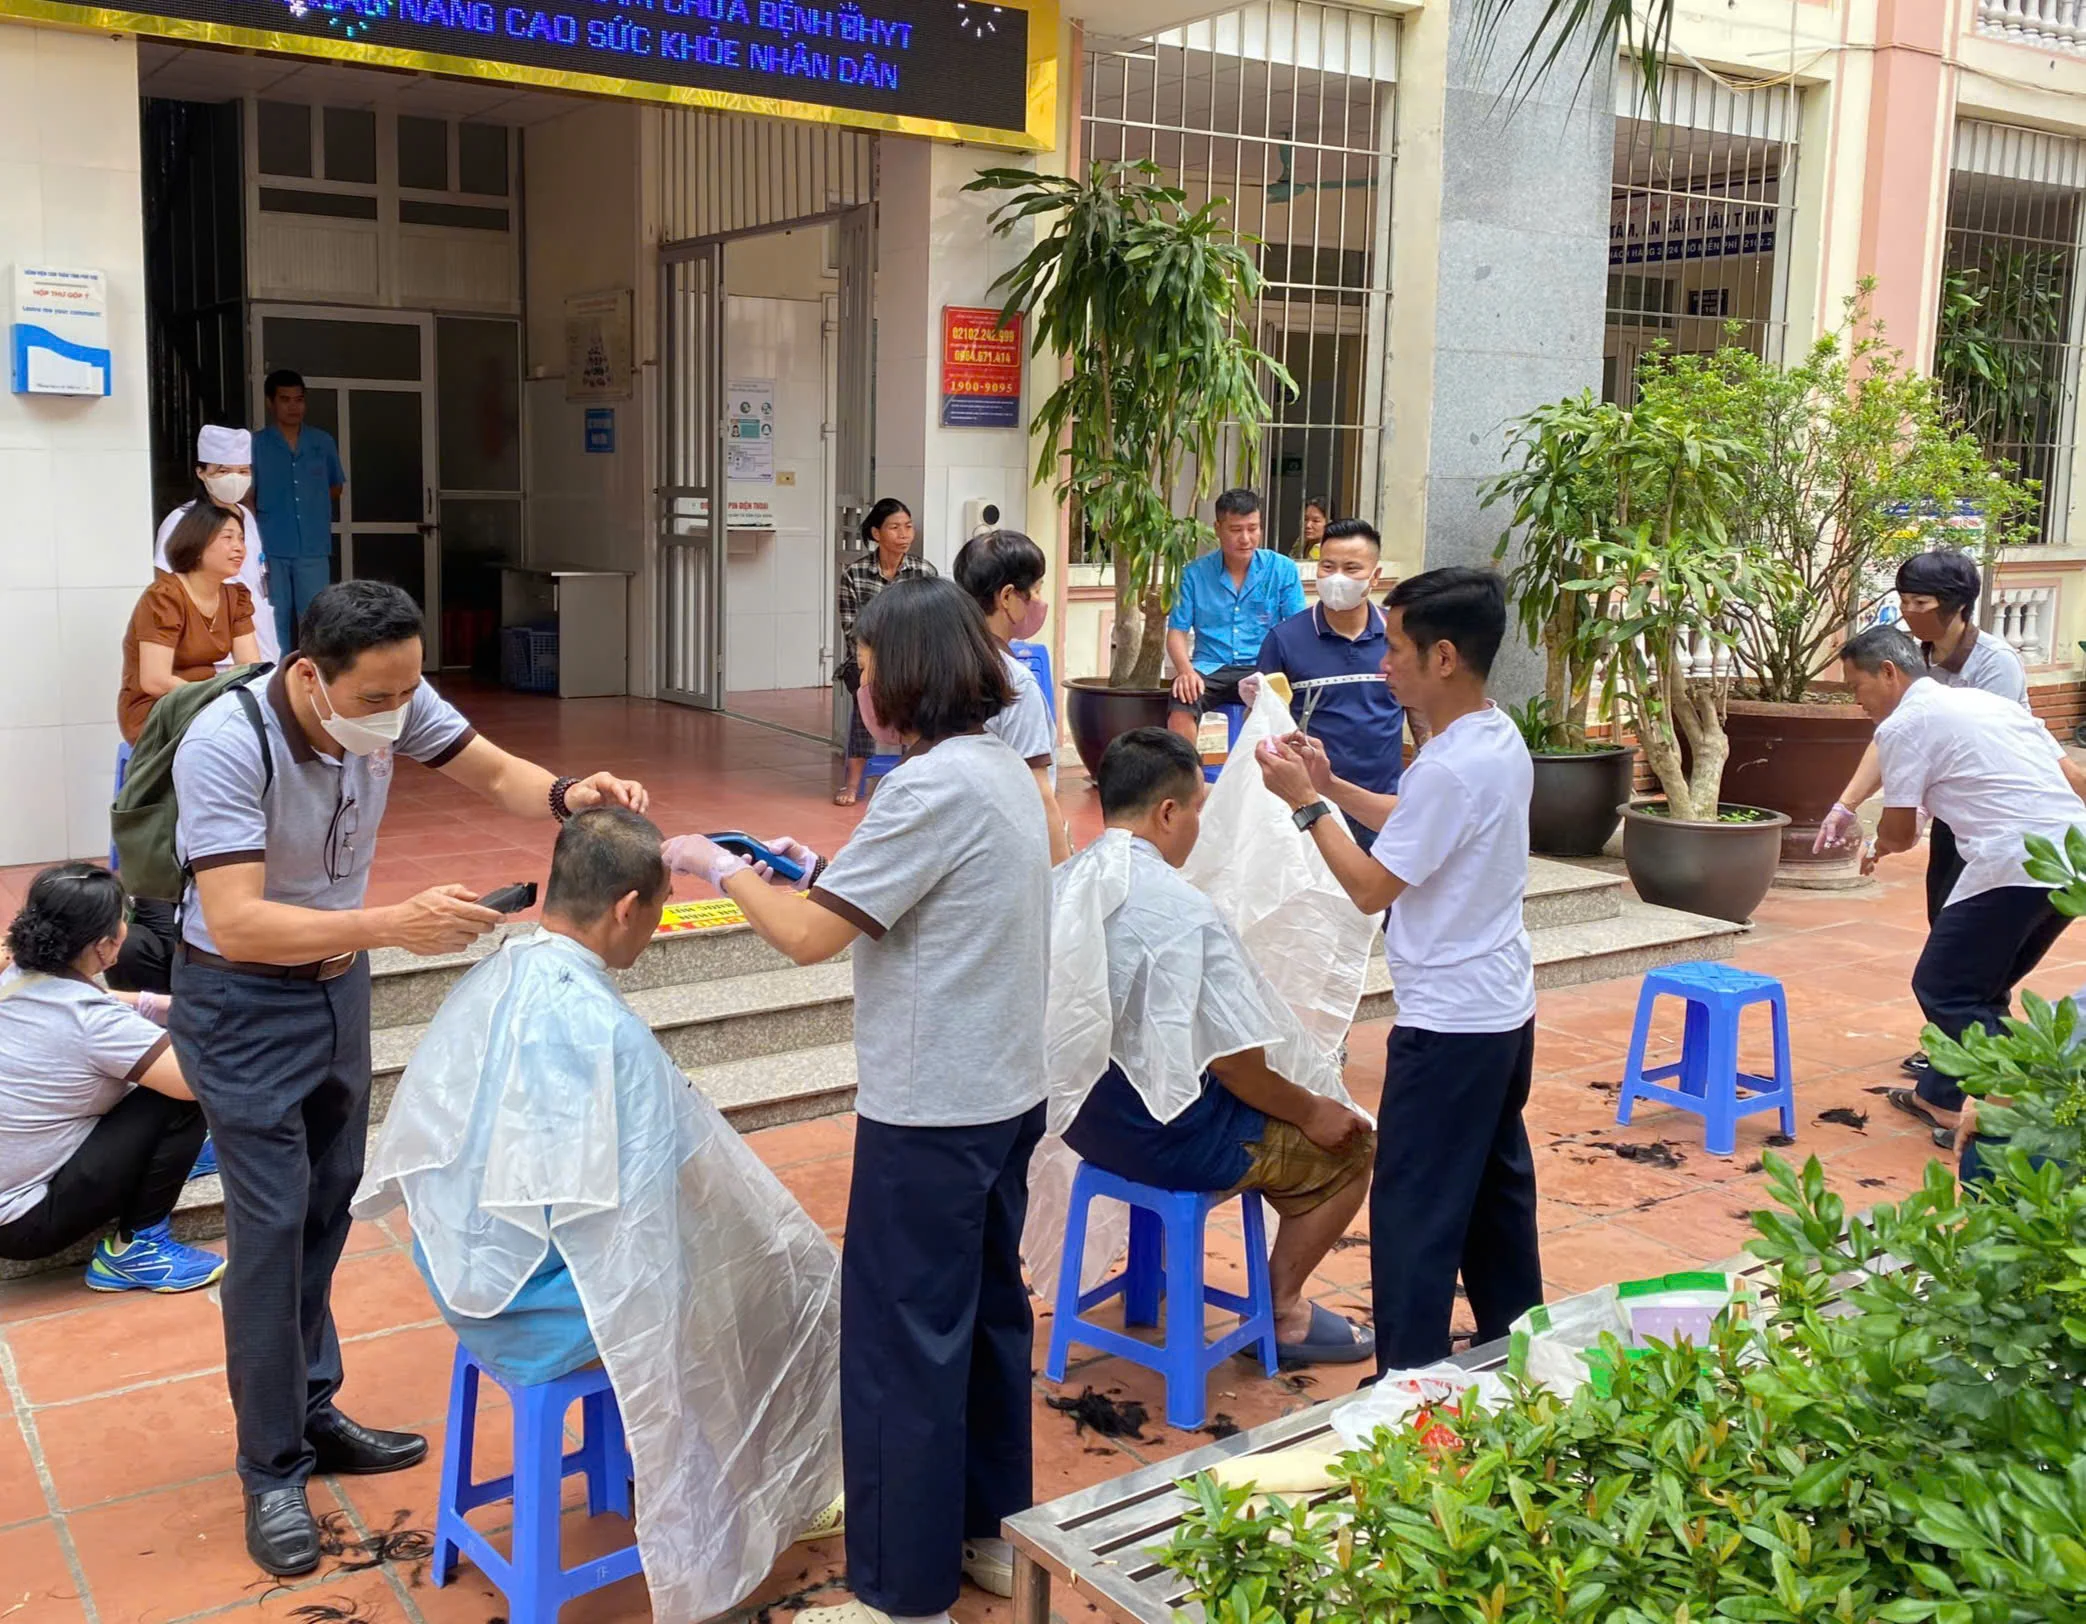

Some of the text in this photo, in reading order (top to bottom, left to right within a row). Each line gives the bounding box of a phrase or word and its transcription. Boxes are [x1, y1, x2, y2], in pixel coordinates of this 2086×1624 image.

[760, 0, 833, 38] BỆNH
[505, 8, 577, 45] CAO
[588, 15, 650, 54] SỨC
[661, 26, 740, 68] KHỎE
[750, 42, 831, 79] NHÂN
[839, 52, 897, 89] DÂN
[951, 381, 1013, 393] 1900-9095
